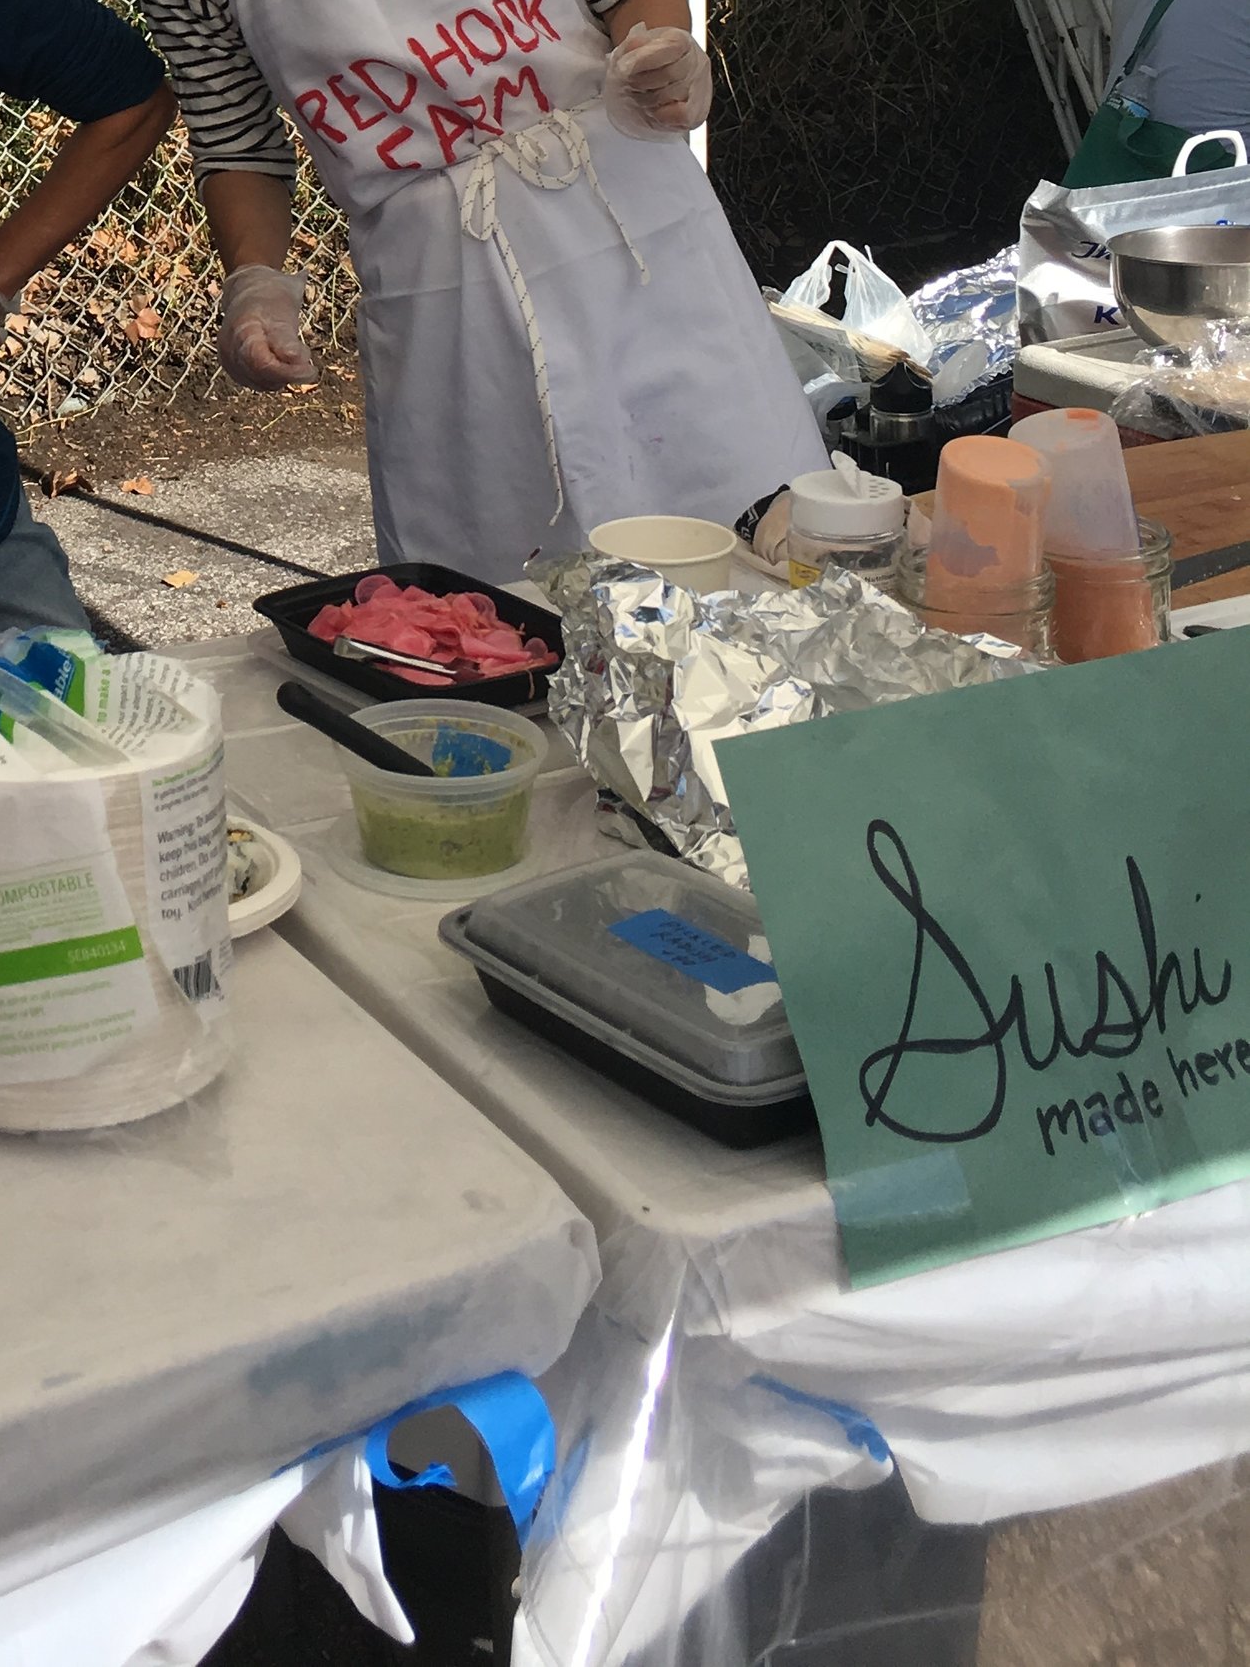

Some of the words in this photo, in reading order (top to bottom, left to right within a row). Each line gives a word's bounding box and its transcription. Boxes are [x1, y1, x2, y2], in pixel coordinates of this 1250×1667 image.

[295, 58, 417, 144] RED
[858, 817, 1233, 1144] Sushi
[1036, 1072, 1164, 1155] made
[1167, 1035, 1250, 1098] here
